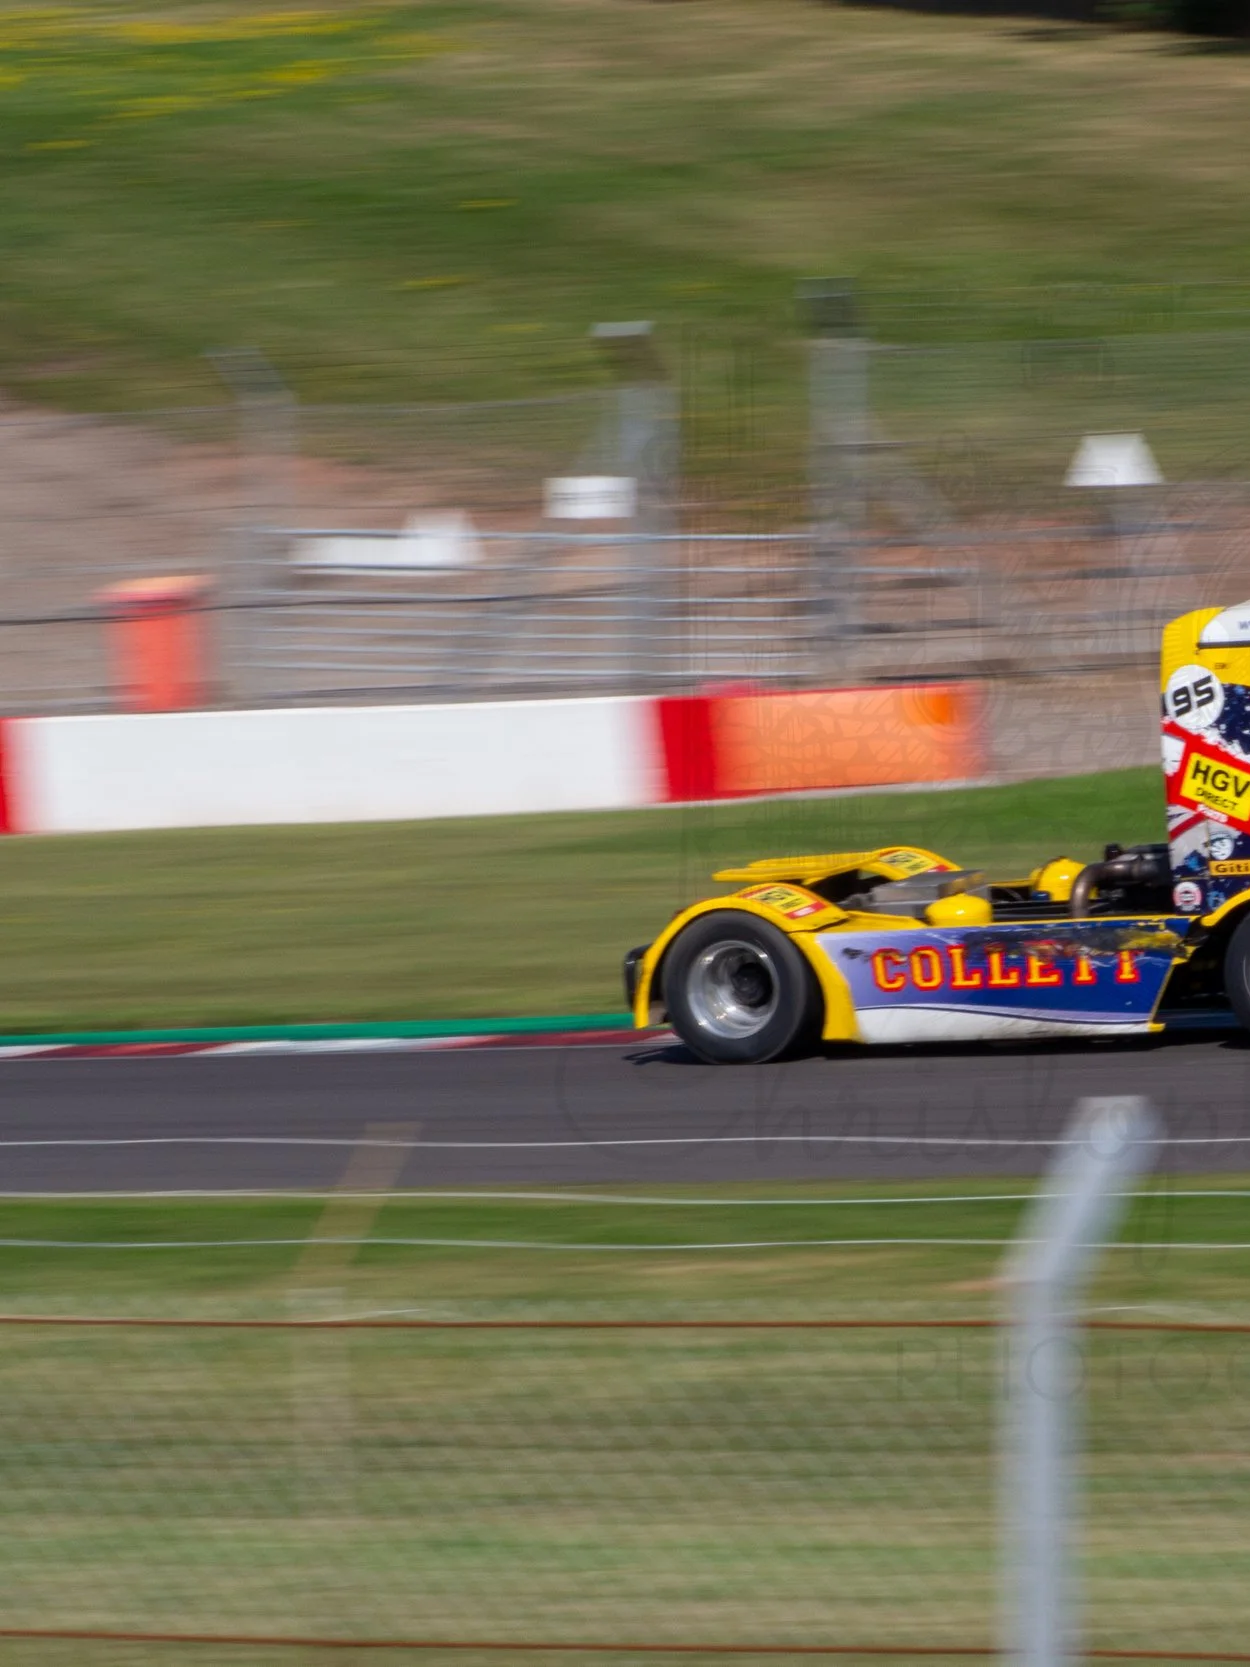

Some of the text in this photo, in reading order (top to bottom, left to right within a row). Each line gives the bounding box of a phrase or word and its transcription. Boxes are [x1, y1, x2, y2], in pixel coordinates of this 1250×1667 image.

[1172, 675, 1216, 717] 95
[1195, 786, 1239, 811] DIRECT
[1215, 863, 1249, 873] Giti
